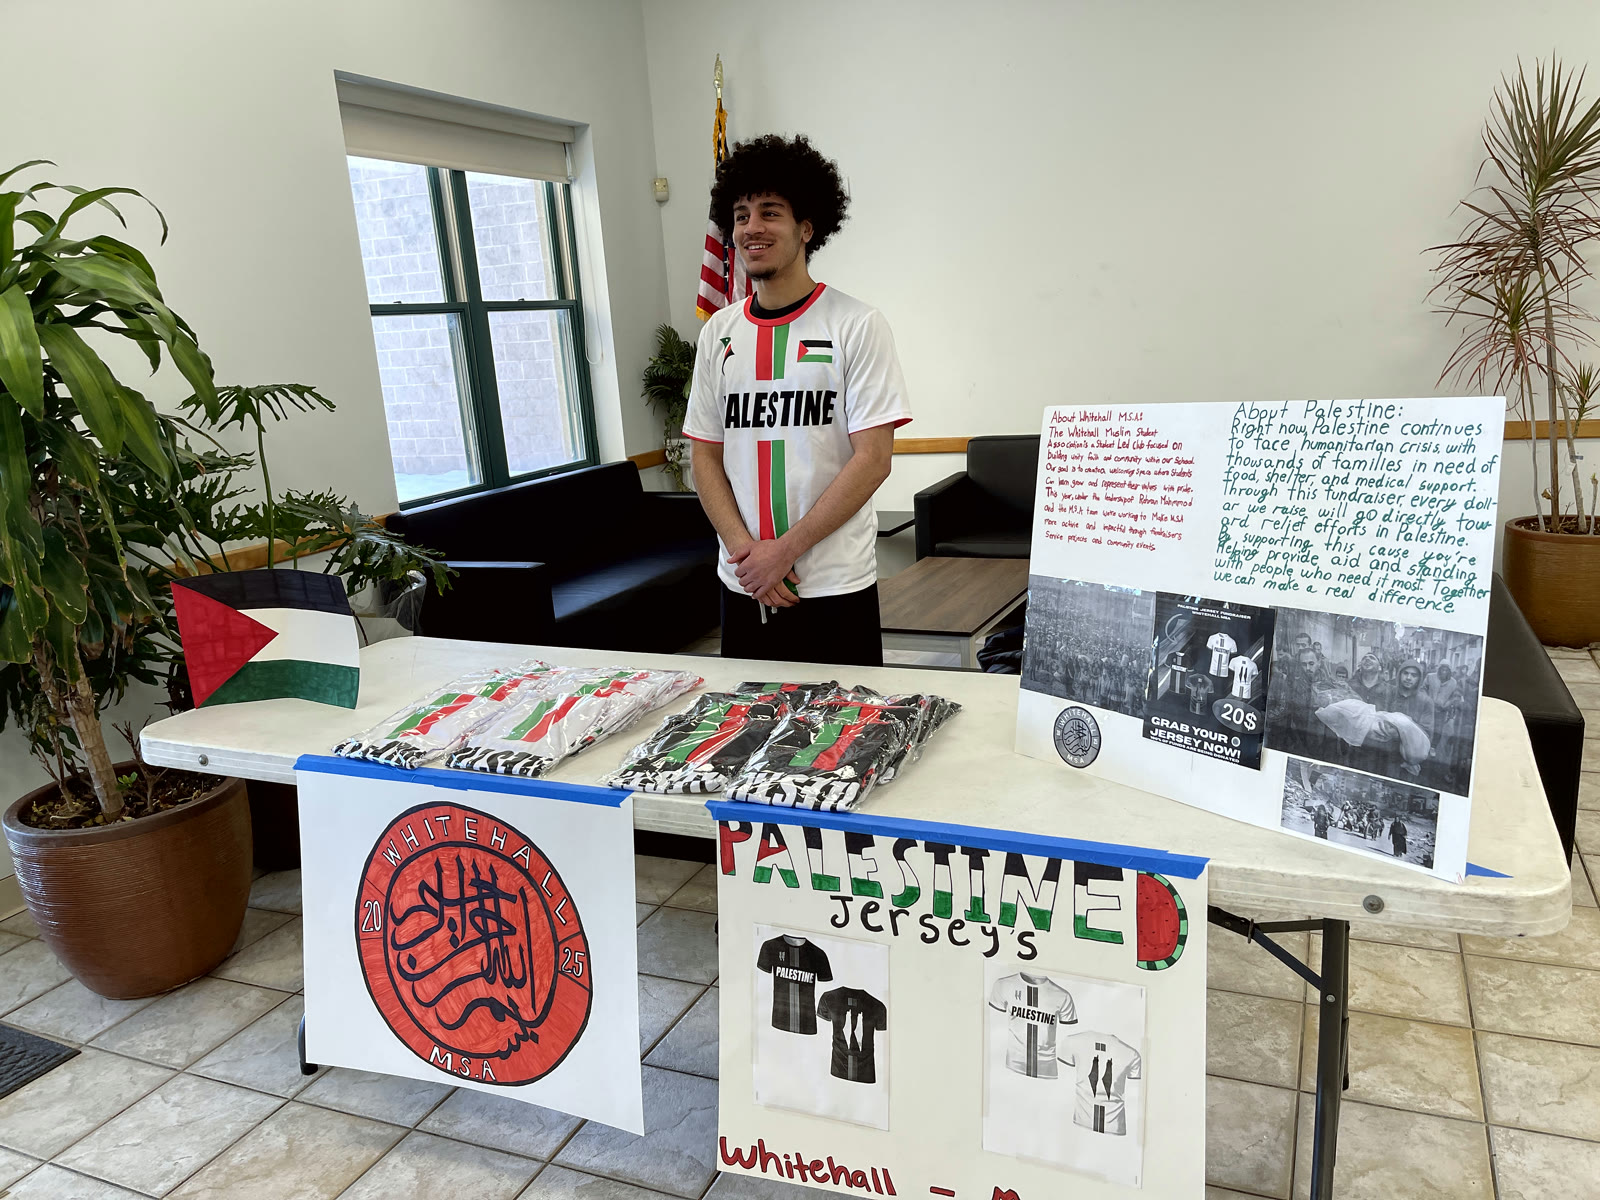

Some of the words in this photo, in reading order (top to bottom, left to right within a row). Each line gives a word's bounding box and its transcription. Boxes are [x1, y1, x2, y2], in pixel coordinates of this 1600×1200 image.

[723, 390, 838, 429] ALESTINE
[1051, 410, 1076, 423] About
[1079, 410, 1112, 422] Whitehall
[1234, 400, 1288, 419] About
[1304, 399, 1403, 419] Palestine:
[1049, 426, 1064, 438] The
[1067, 425, 1099, 438] Whitehall
[1105, 425, 1131, 437] Muslim
[1136, 427, 1158, 437] Student
[1231, 417, 1273, 438] Right
[1312, 415, 1389, 435] Palestine
[1400, 418, 1482, 436] continues
[1117, 438, 1130, 449] Led
[1132, 439, 1145, 450] Club
[1146, 439, 1169, 449] focused
[1228, 432, 1244, 450] to
[1254, 433, 1290, 451] face
[1301, 434, 1394, 453] humanitarian
[1446, 438, 1476, 454] with
[1226, 450, 1304, 470] thousands
[1312, 450, 1330, 470] of
[1332, 451, 1402, 472] families
[1412, 459, 1427, 473] in
[1433, 457, 1476, 475] need
[1481, 454, 1499, 474] of
[1224, 466, 1259, 484] food,
[1321, 472, 1350, 485] and
[1355, 473, 1413, 489] medical
[1419, 478, 1477, 495] support.
[1223, 479, 1278, 503] Through
[1288, 481, 1318, 501] this
[1410, 494, 1457, 513] every
[1140, 512, 1147, 520] to
[1221, 514, 1250, 528] ard
[1261, 515, 1308, 533] relief
[1314, 518, 1366, 536] efforts
[1376, 524, 1389, 538] in
[1396, 522, 1468, 547] Palestine.
[1222, 502, 1240, 511] ar
[1248, 504, 1267, 514] we
[1272, 505, 1306, 516] raise
[1318, 502, 1348, 518] will
[1382, 508, 1446, 531] directly
[1243, 532, 1314, 553] supporting
[1324, 534, 1355, 554] this
[1369, 545, 1409, 558] cause
[1418, 550, 1477, 567] you're
[1214, 555, 1243, 570] with
[1250, 559, 1294, 579] people
[1300, 566, 1332, 580] who
[1337, 571, 1373, 586] need
[1376, 573, 1389, 588] it
[1433, 579, 1490, 602] Together
[1265, 550, 1319, 566] provide
[1331, 553, 1361, 568] aid
[1369, 557, 1401, 573] and
[1407, 564, 1477, 587] standing
[1213, 571, 1232, 582] we
[1234, 576, 1255, 585] can
[1263, 577, 1300, 591] make
[1306, 585, 1317, 593] a
[1325, 586, 1355, 598] real
[1150, 716, 1190, 733] GRAB
[1191, 726, 1229, 744] YOUR
[1220, 703, 1258, 731] 20$
[1149, 728, 1202, 748] JERSEY
[1203, 742, 1241, 759] NOW!
[382, 815, 567, 926] WHITEHALL
[361, 900, 383, 933] 20
[830, 895, 1039, 961] Jersey's
[560, 948, 586, 977] 25
[775, 966, 815, 984] PALESTINE
[1011, 1005, 1056, 1025] PALESTINE
[429, 1045, 497, 1082] M.S.A
[719, 1135, 897, 1196] Whitehall
